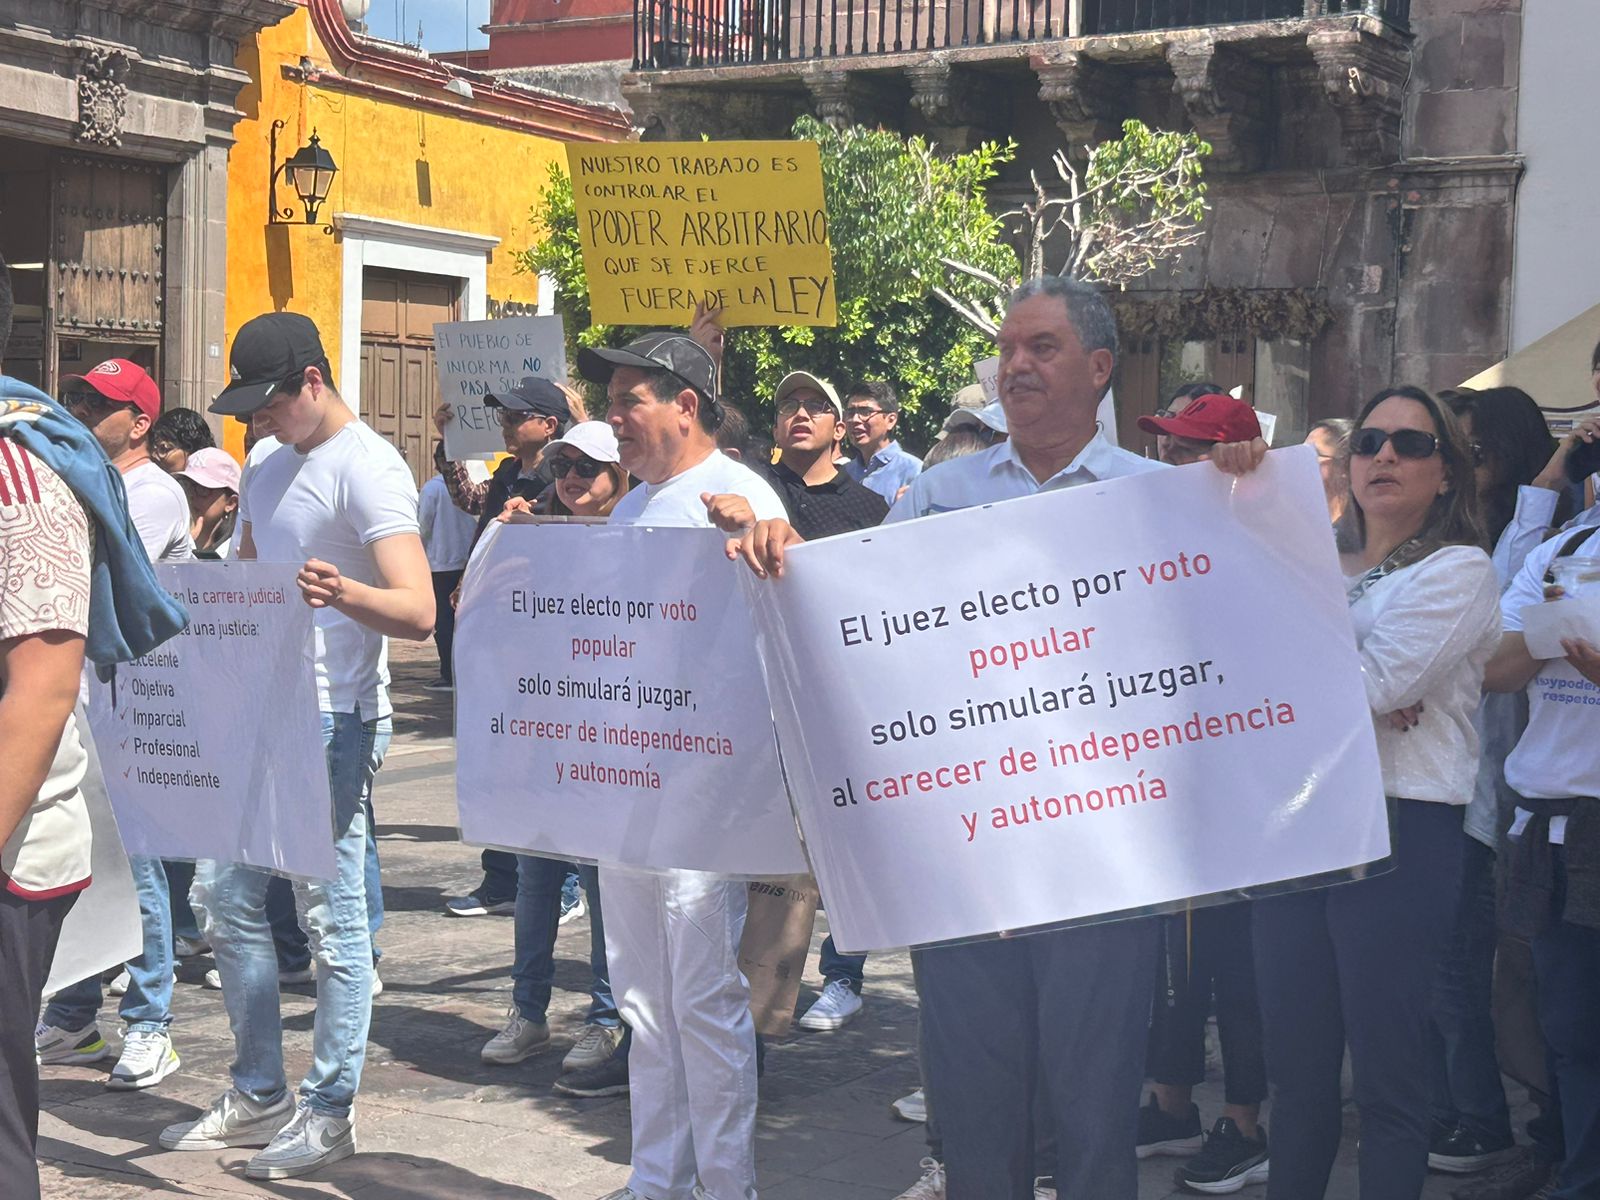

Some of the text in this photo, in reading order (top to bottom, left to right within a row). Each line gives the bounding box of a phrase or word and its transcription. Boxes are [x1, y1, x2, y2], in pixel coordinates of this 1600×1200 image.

[581, 156, 798, 176] NUESTRO TRABAJO ES
[584, 184, 718, 203] CONTROLAR EL
[588, 209, 827, 248] PODER ARBITRARIO
[604, 256, 769, 276] QUE SE EJERCE
[738, 286, 767, 306] LA
[769, 276, 829, 319] LEY
[515, 333, 533, 346] SE
[522, 357, 542, 372] NO
[460, 380, 492, 396] PASA
[188, 587, 199, 605] la
[203, 590, 245, 604] carrera
[247, 587, 286, 608] judicial
[512, 590, 697, 625] El juez electo por voto
[839, 551, 1212, 647] El juez electo por voto
[194, 623, 216, 636] una
[218, 618, 260, 640] justicia:
[571, 634, 637, 662] popular
[968, 625, 1096, 680] popular
[131, 678, 175, 700] Objetiva
[518, 672, 697, 712] solo simulará juzgar,
[870, 659, 1225, 746] solo simulará juzgar,
[133, 707, 187, 730] Imparcial
[490, 712, 733, 756] al carecer de independencia
[133, 736, 201, 758] Profesional
[832, 697, 1295, 808] al carecer de independencia
[136, 766, 221, 790] Independiente
[555, 760, 661, 790] y autonomía
[960, 768, 1168, 843] y autonomía
[749, 881, 786, 898] enis
